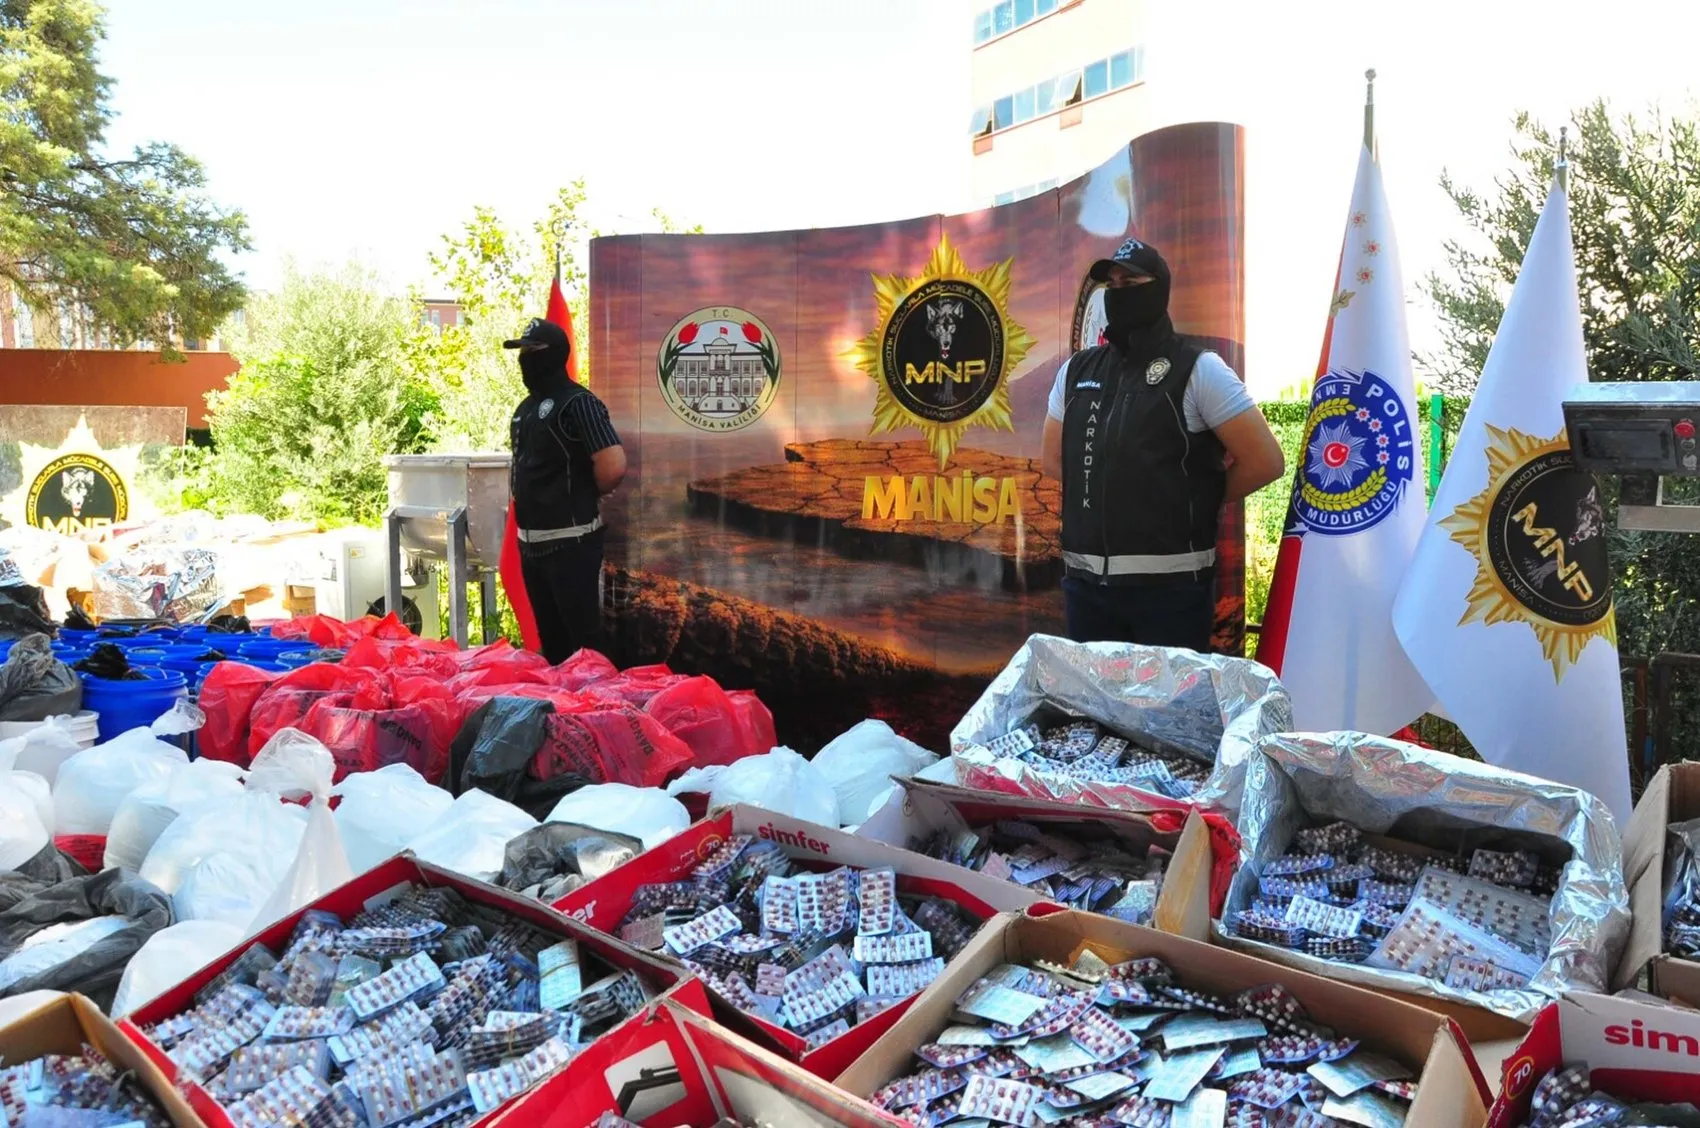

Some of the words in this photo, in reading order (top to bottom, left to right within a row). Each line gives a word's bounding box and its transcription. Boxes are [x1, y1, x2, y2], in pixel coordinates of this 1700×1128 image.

[904, 359, 986, 385] MNP
[677, 405, 715, 429] MANİSA
[1365, 383, 1412, 470] POLİS
[1082, 400, 1101, 509] NARKOTİK
[861, 469, 1020, 524] MANİSA
[1307, 481, 1397, 525] MÜDÜRLÜĞÜ
[1501, 460, 1549, 507] NARKOTİK
[1511, 502, 1593, 601] MNP
[758, 822, 831, 855] simfer
[1604, 1019, 1700, 1057] sim
[1514, 1063, 1531, 1085] 70
